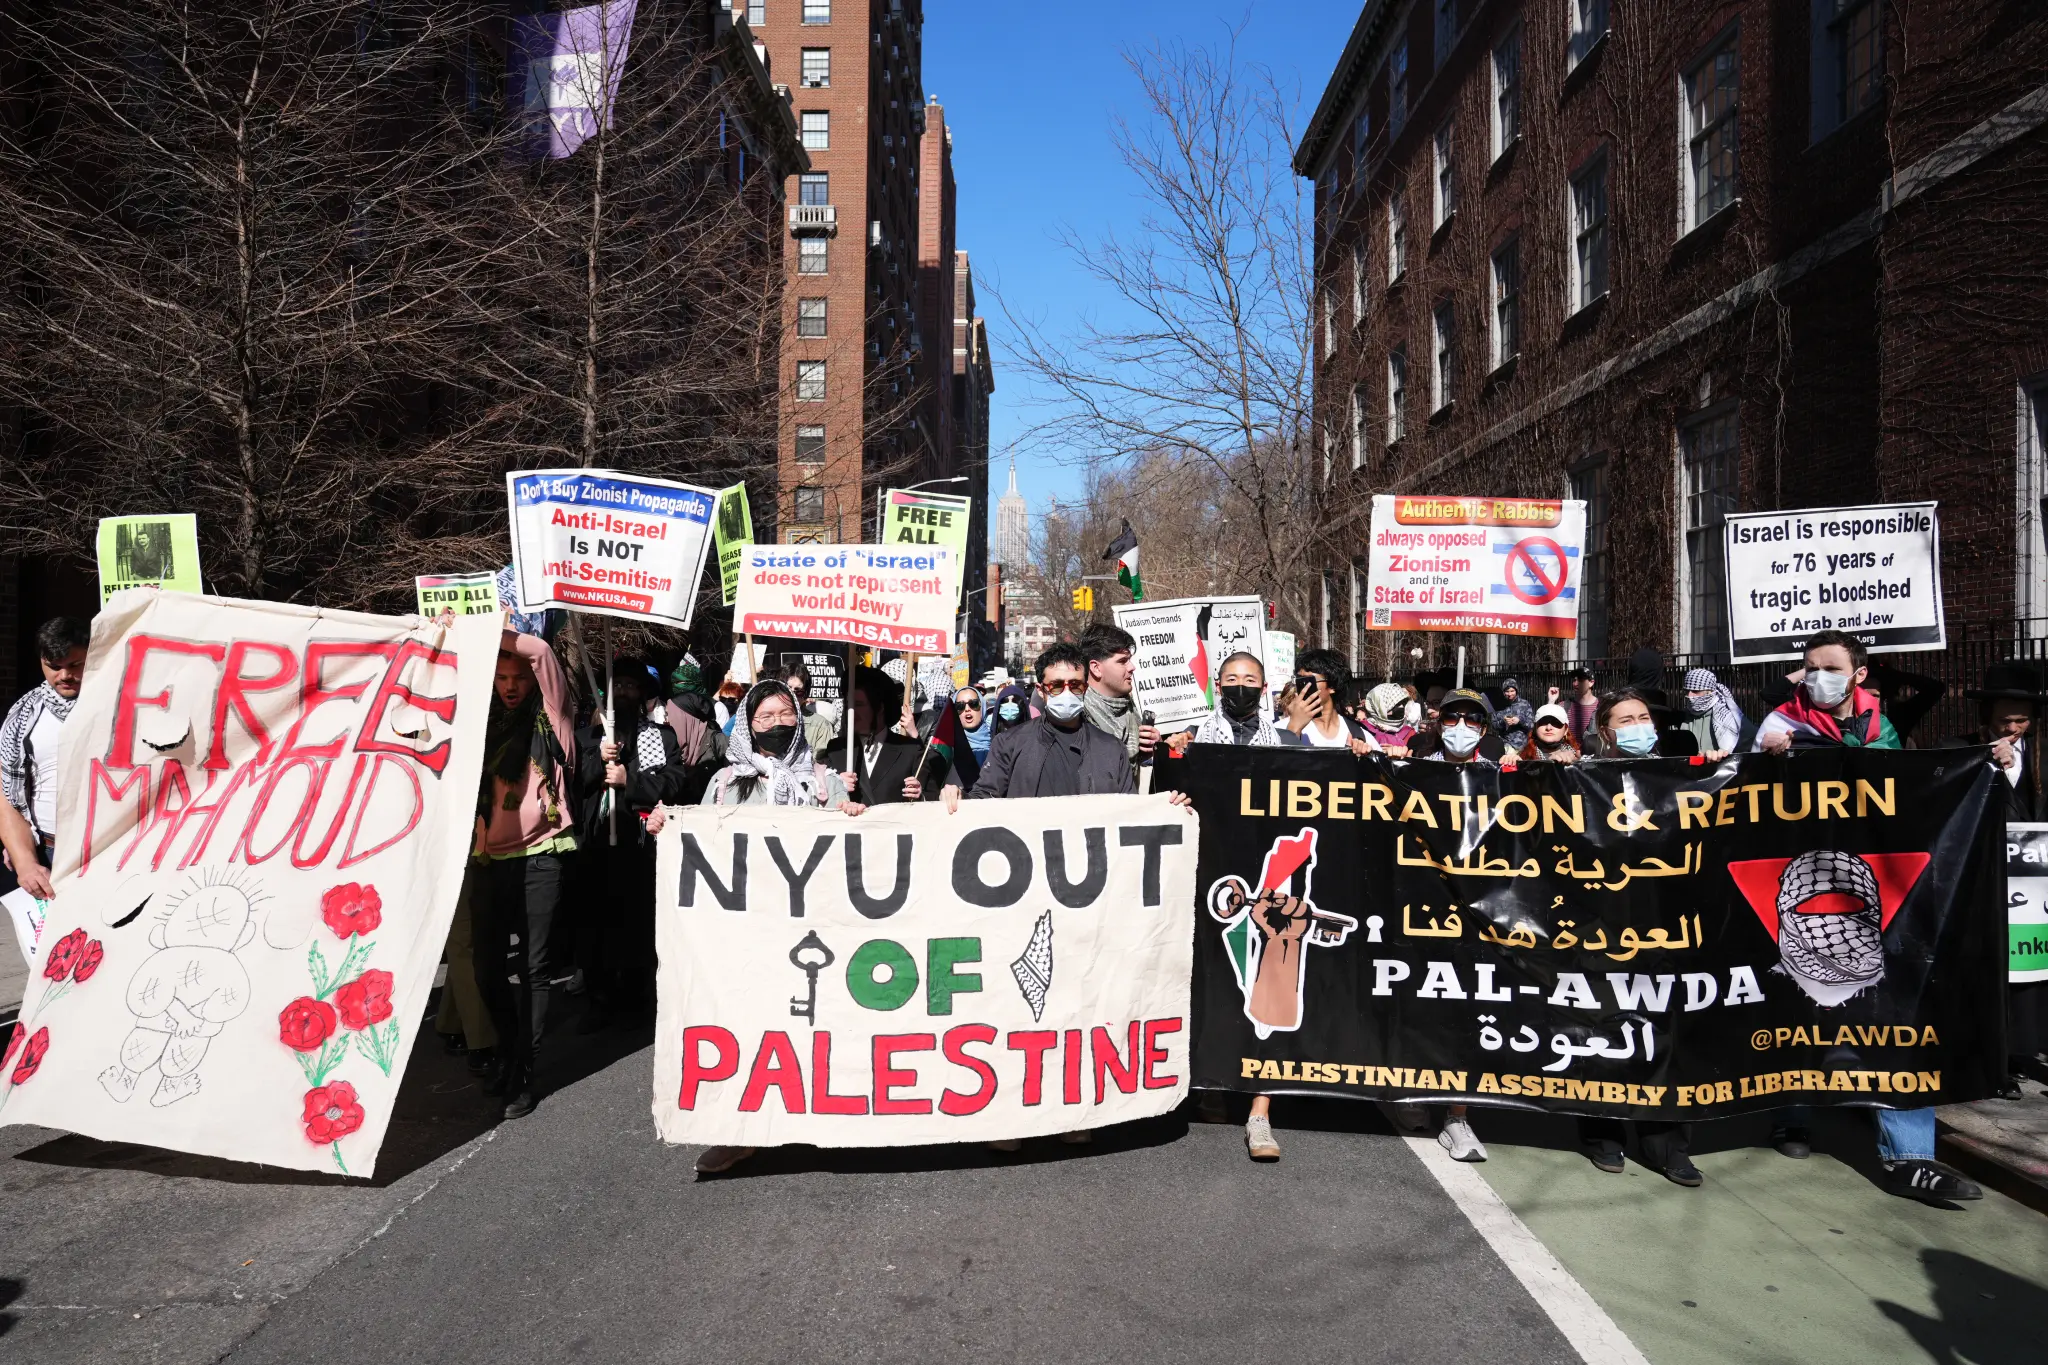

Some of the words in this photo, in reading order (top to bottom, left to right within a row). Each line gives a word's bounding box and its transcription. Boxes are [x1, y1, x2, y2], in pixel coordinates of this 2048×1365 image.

[520, 480, 549, 500] Don't
[552, 480, 578, 501] Buy
[582, 482, 627, 503] Zionist
[631, 489, 705, 517] Propaganda
[1401, 499, 1487, 519] Authentic
[1492, 501, 1555, 520] Rabbis
[551, 508, 667, 540] Anti-Israel
[897, 506, 952, 528] FREE
[1733, 519, 1790, 544] Israel
[1796, 519, 1813, 539] is
[1820, 512, 1931, 541] responsible
[897, 527, 939, 544] ALL
[1377, 528, 1424, 550] always
[1428, 530, 1486, 550] opposed
[570, 536, 589, 554] Is
[597, 539, 643, 562] NOT
[751, 551, 816, 568] State
[824, 550, 848, 568] of
[1388, 555, 1471, 572] Zionism
[1771, 561, 1789, 574] for
[1792, 552, 1816, 572] 76
[1826, 551, 1876, 576] years
[1881, 553, 1894, 566] of
[754, 571, 801, 585] does
[807, 574, 844, 589] not
[849, 574, 942, 595] represent
[1409, 576, 1429, 585] and
[1432, 575, 1449, 585] the
[422, 590, 458, 602] END
[464, 589, 491, 601] ALL
[562, 589, 645, 610] www.NKUSA.org
[792, 593, 845, 609] world
[850, 593, 903, 621] Jewry
[1374, 586, 1414, 604] State
[1419, 586, 1434, 604] of
[1440, 587, 1484, 604] Israel
[1750, 585, 1811, 612] tragic
[1818, 578, 1911, 604] bloodshed
[466, 604, 493, 615] AID
[1125, 617, 1151, 628] Judaism
[1151, 614, 1182, 625] Demands
[1218, 624, 1248, 643] الحرية
[1419, 616, 1529, 632] www.NKUSA.org
[1770, 618, 1786, 632] of
[1791, 616, 1832, 631] Arab
[1837, 613, 1861, 627] and
[1865, 612, 1894, 625] Jew
[753, 619, 939, 650] www.NKUSA.org
[1140, 633, 1175, 646] FREEDOM
[803, 654, 814, 664] WE
[815, 655, 828, 665] SEE
[1139, 658, 1151, 669] for
[1152, 655, 1170, 668] GAZA
[1171, 654, 1185, 665] and
[826, 688, 840, 697] SEA
[1138, 679, 1155, 691] ALL
[1155, 673, 1196, 689] PALESTINE
[105, 632, 458, 780] FREE
[78, 752, 423, 877] MAHMOUD
[1241, 778, 1585, 834] LIBERATION
[1606, 790, 1660, 833] &
[1676, 777, 1896, 830] RETURN
[1397, 834, 1541, 880] مطلبنا
[1552, 841, 1702, 891] الحرية
[678, 832, 913, 919] NYU
[951, 824, 1182, 908] OUT
[846, 937, 983, 1016] OF
[1372, 959, 1765, 1013] PAL-AWDA
[1477, 1014, 1654, 1071] العودة
[1750, 1025, 1940, 1051] @PALAWDA
[678, 1017, 1183, 1116] PALESTINE
[1241, 1057, 1467, 1092] PALESTINIAN
[1477, 1073, 1667, 1106] ASSEMBLY
[1677, 1079, 1734, 1107] FOR
[1739, 1069, 1941, 1099] LIBERATION
